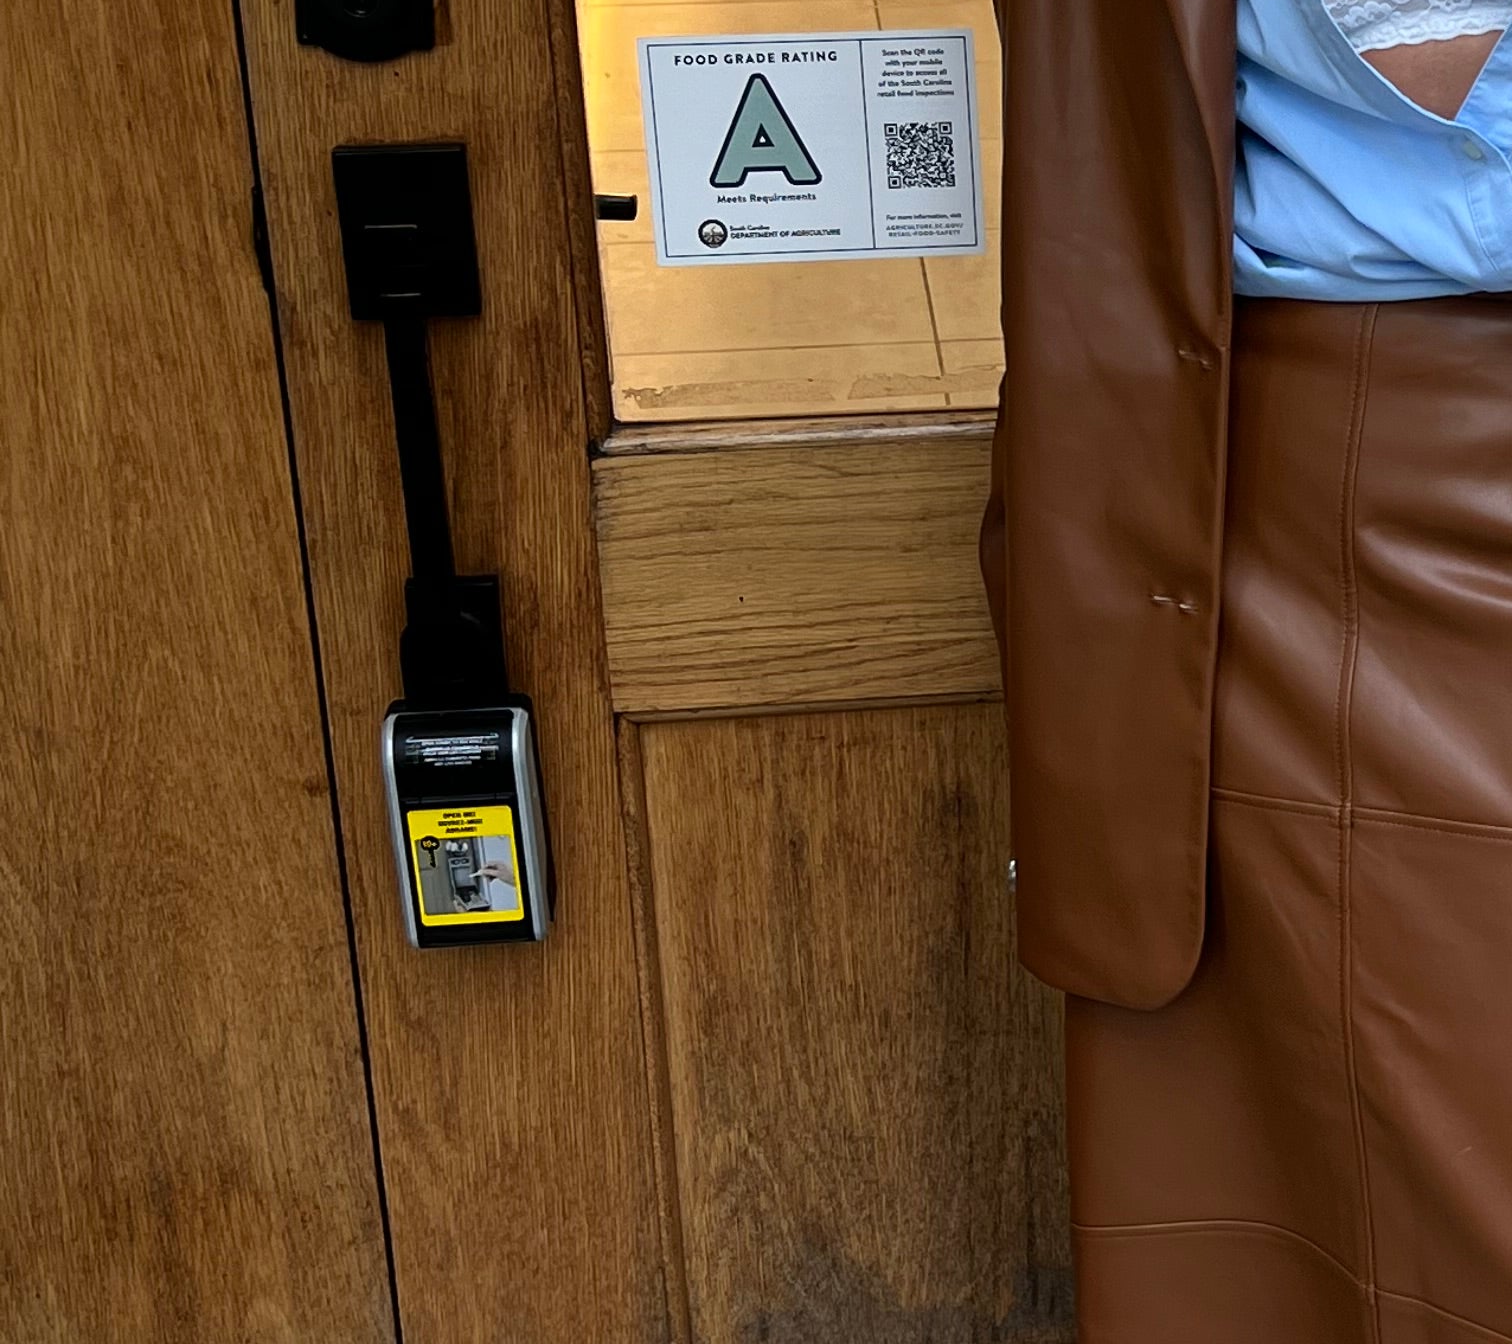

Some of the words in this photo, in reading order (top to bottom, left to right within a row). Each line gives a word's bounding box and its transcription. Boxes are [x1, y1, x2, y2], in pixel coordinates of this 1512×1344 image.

[674, 54, 718, 66] FOOD
[724, 52, 776, 65] GRADE
[781, 51, 838, 63] RATING
[709, 72, 823, 188] A
[717, 195, 747, 203] Meets
[749, 193, 816, 204] Requirements
[730, 231, 779, 239] DEPARTMENT
